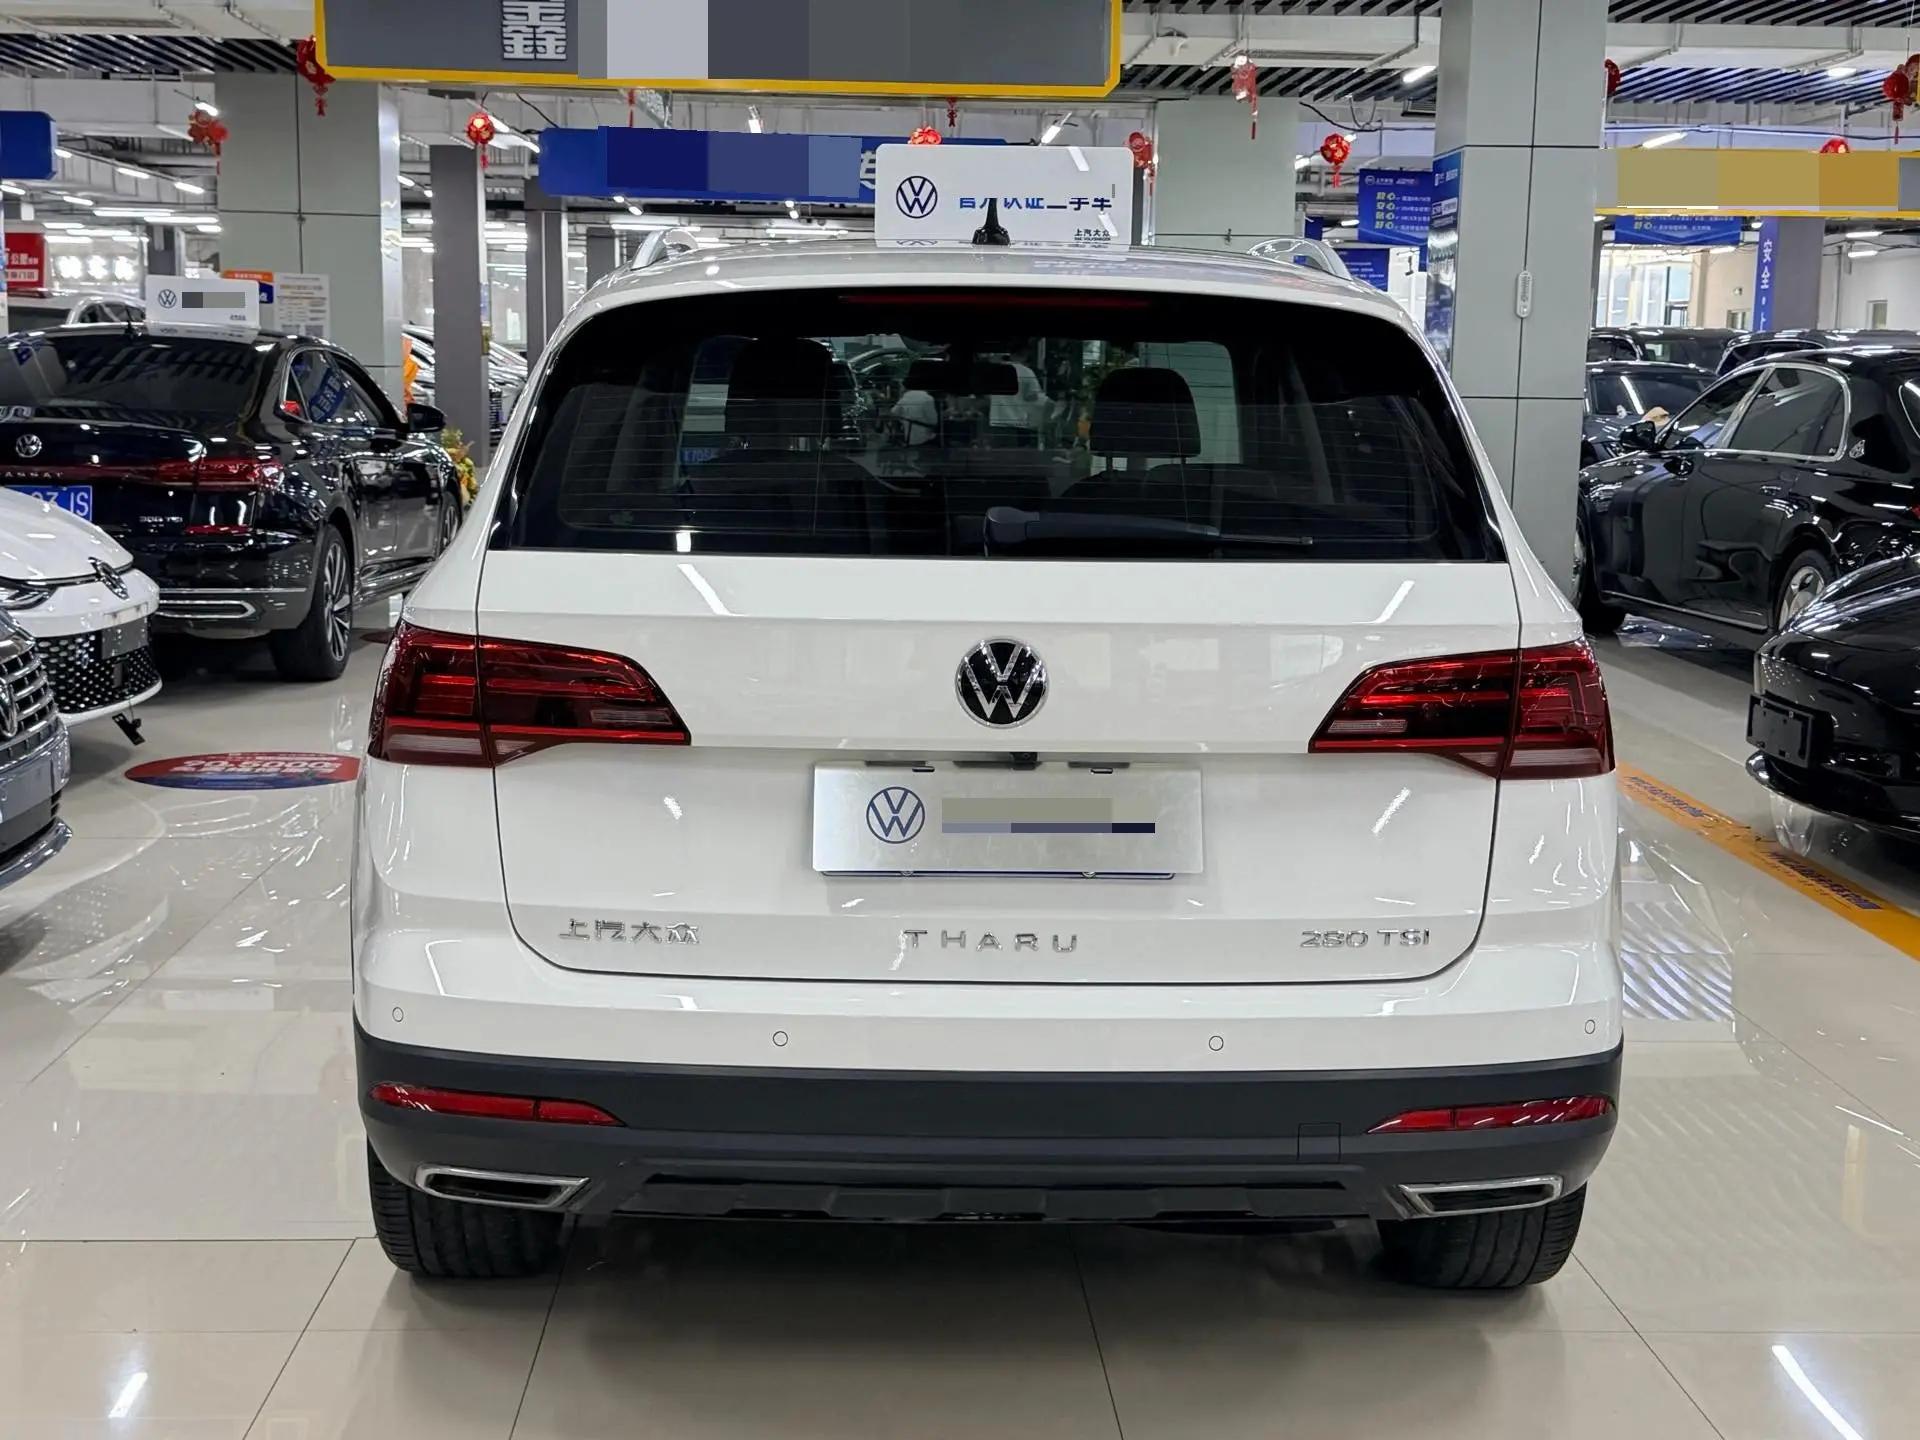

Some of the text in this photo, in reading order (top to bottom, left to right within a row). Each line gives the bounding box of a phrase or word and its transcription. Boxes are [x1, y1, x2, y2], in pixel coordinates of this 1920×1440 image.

[558, 918, 699, 944] 上汽大众
[903, 930, 1077, 952] THARU
[1300, 928, 1430, 948] 280 TSI
